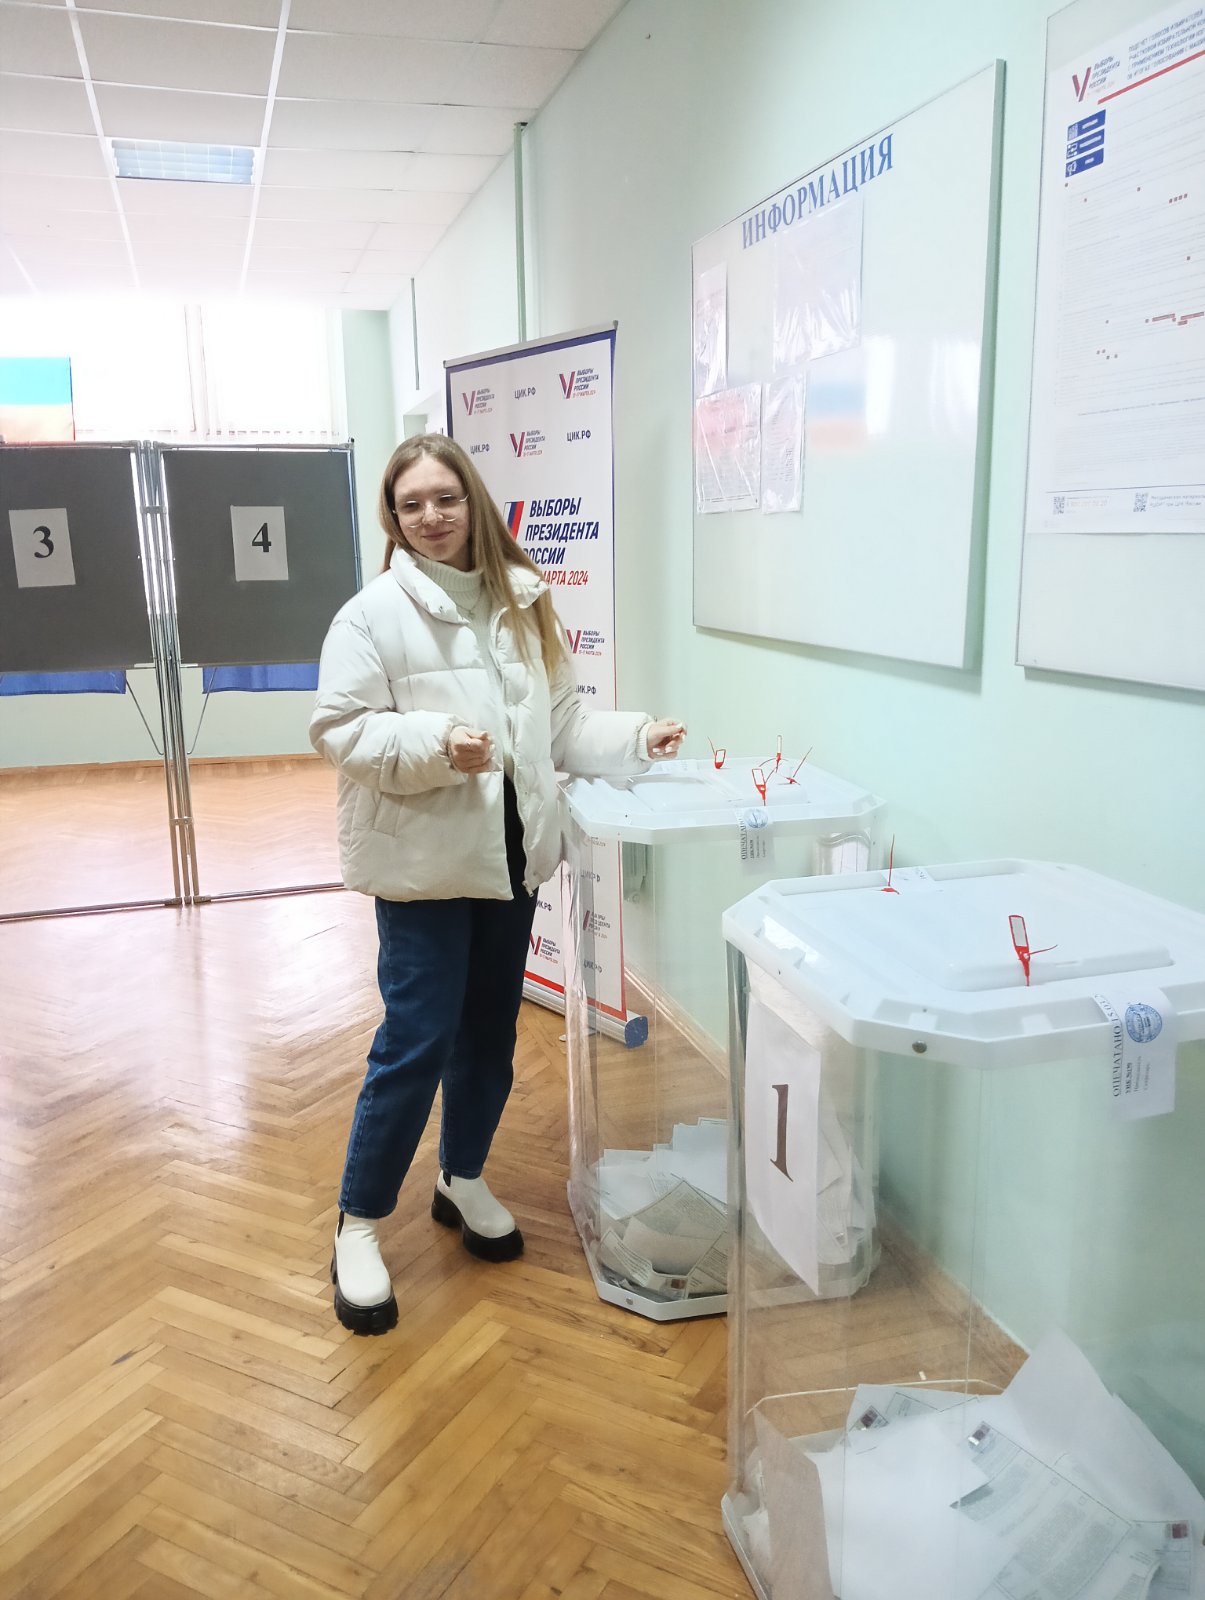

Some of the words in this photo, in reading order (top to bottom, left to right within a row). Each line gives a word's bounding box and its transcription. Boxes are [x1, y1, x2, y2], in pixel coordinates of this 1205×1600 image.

[741, 133, 893, 250] ИНФОРМАЦИЯ
[514, 386, 536, 399] ЦИК.РФ
[566, 429, 592, 442] ЦИК.РФ
[470, 443, 490, 455] ЦИК.РФ
[529, 497, 582, 518] ВЫБОРЫ
[33, 525, 54, 558] 3
[251, 522, 272, 553] 4
[525, 521, 599, 543] ПРЕЗИДЕНТА
[567, 570, 589, 585] 2024
[576, 684, 597, 695] ИК.РФ
[536, 900, 553, 912] ИК.РФ
[1112, 1024, 1123, 1098] ОПЕЧАТАНО
[770, 1083, 794, 1183] 1
